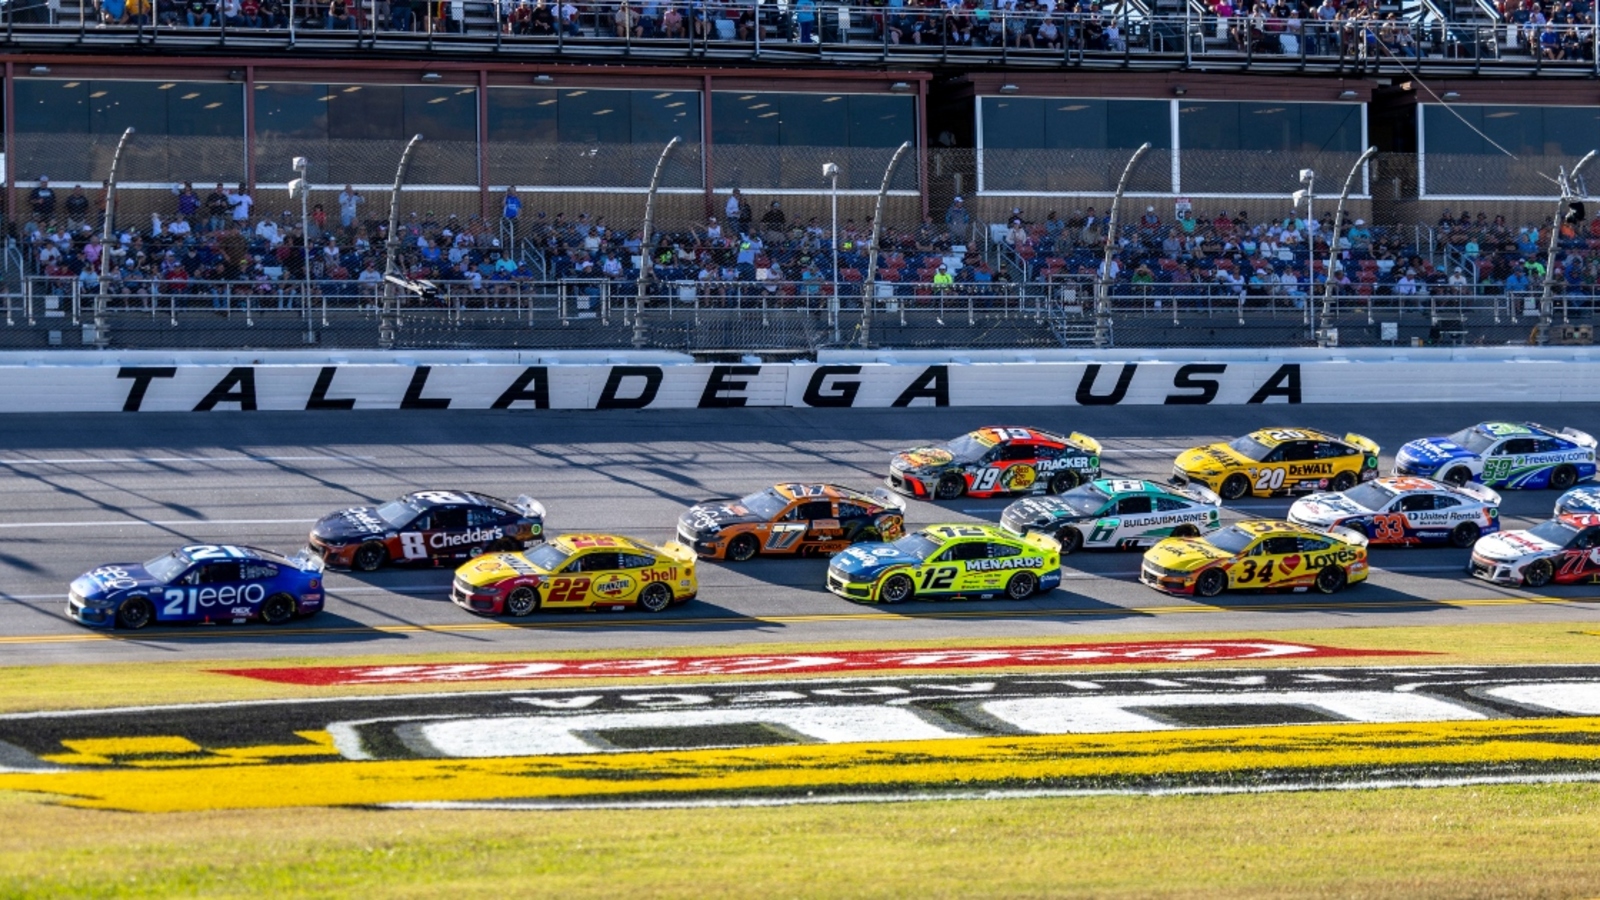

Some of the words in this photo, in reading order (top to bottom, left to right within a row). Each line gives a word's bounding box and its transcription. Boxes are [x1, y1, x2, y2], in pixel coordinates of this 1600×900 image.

[117, 364, 951, 411] TALLADEGA
[1074, 363, 1303, 406] USA
[1037, 456, 1088, 471] TRACKER
[1524, 451, 1588, 465] Freeway.com
[970, 467, 1001, 490] 19
[1255, 468, 1286, 490] 20
[1123, 512, 1208, 528] BUILDSUBMARINES
[1373, 514, 1405, 538] 33
[1420, 511, 1448, 521] United
[1450, 511, 1481, 520] Rentals
[400, 532, 427, 559] 8
[429, 525, 504, 549] Cheddar's
[764, 522, 807, 550] 17
[641, 567, 677, 582] Shell
[965, 557, 1044, 571] MENARDS
[1237, 560, 1275, 583] 34
[920, 567, 958, 589] 12
[163, 588, 196, 615] 21
[199, 583, 265, 606] eero
[547, 578, 591, 602] 22
